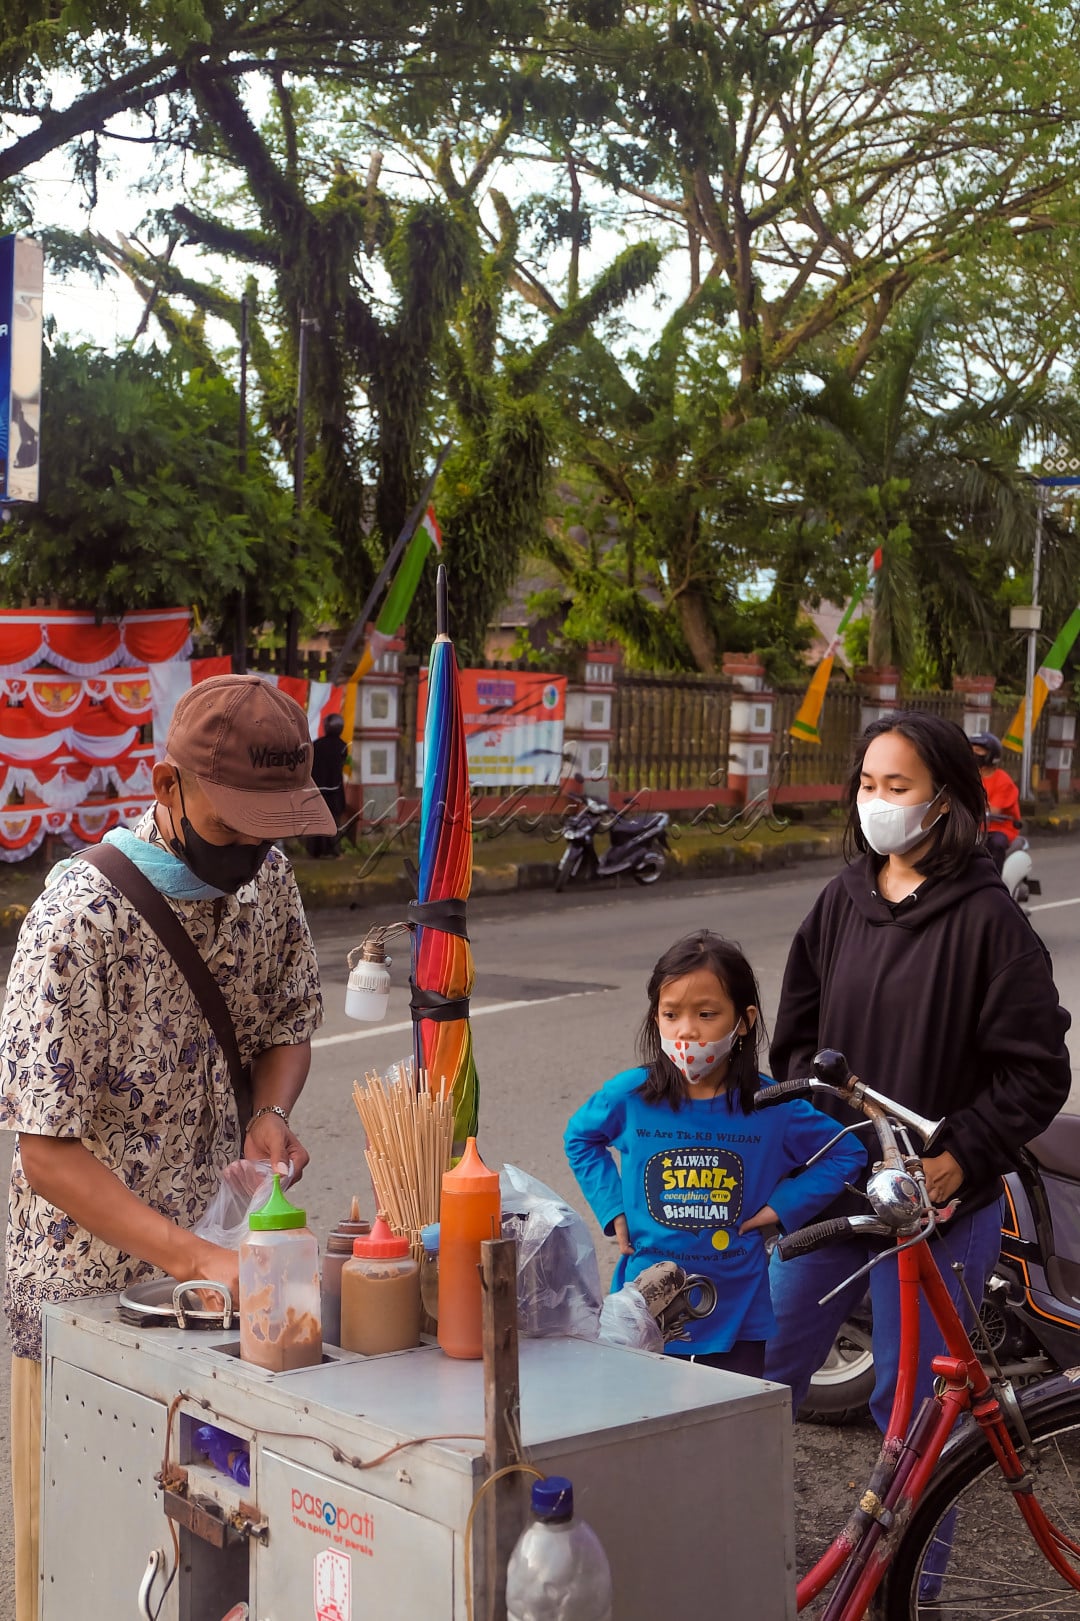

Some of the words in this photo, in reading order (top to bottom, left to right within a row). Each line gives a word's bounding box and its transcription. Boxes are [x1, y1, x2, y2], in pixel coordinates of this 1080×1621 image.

[636, 1129, 651, 1137] We
[654, 1129, 673, 1138] Are
[716, 1133, 762, 1144] WILDAN
[674, 1155, 719, 1167] ALWAYS
[662, 1168, 727, 1190] START
[664, 1191, 709, 1204] everything
[291, 1487, 375, 1542] pasopati
